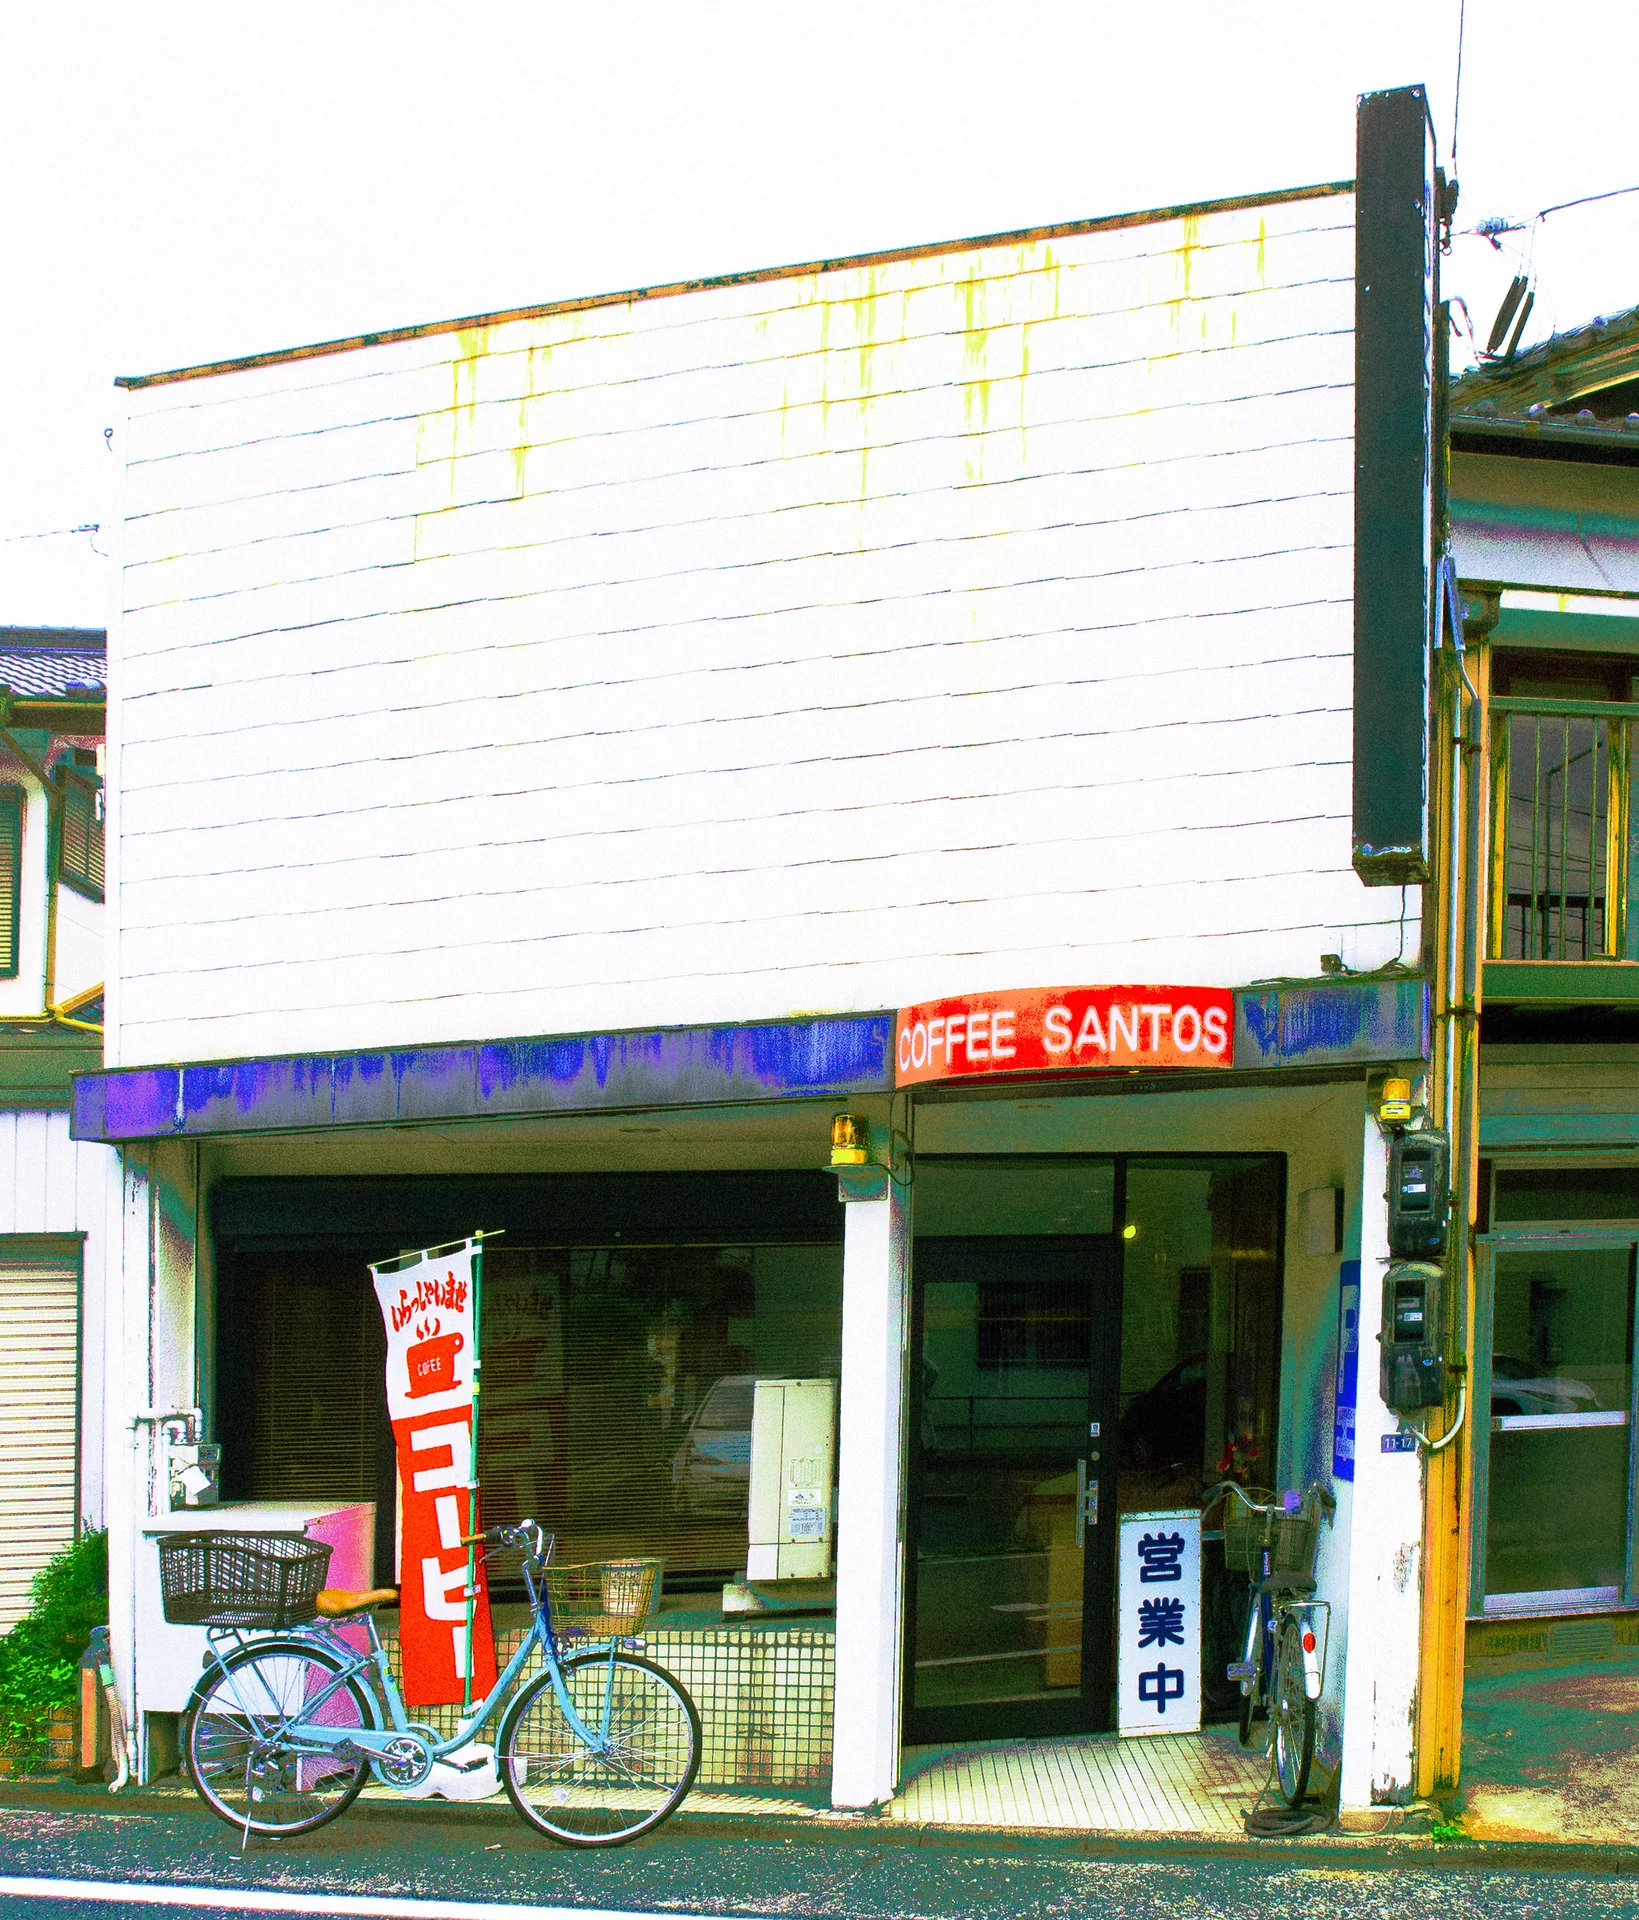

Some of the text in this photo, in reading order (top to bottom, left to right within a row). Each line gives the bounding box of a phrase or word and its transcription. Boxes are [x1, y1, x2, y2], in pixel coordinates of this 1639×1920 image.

[898, 1006, 1227, 1072] COFFEE SANTOS
[391, 1271, 467, 1332] いらっしゃいませ
[417, 1357, 442, 1377] COFEE
[1384, 1437, 1412, 1449] 11-17
[410, 1420, 477, 1679] コーヒー
[1137, 1532, 1185, 1713] 営業中
